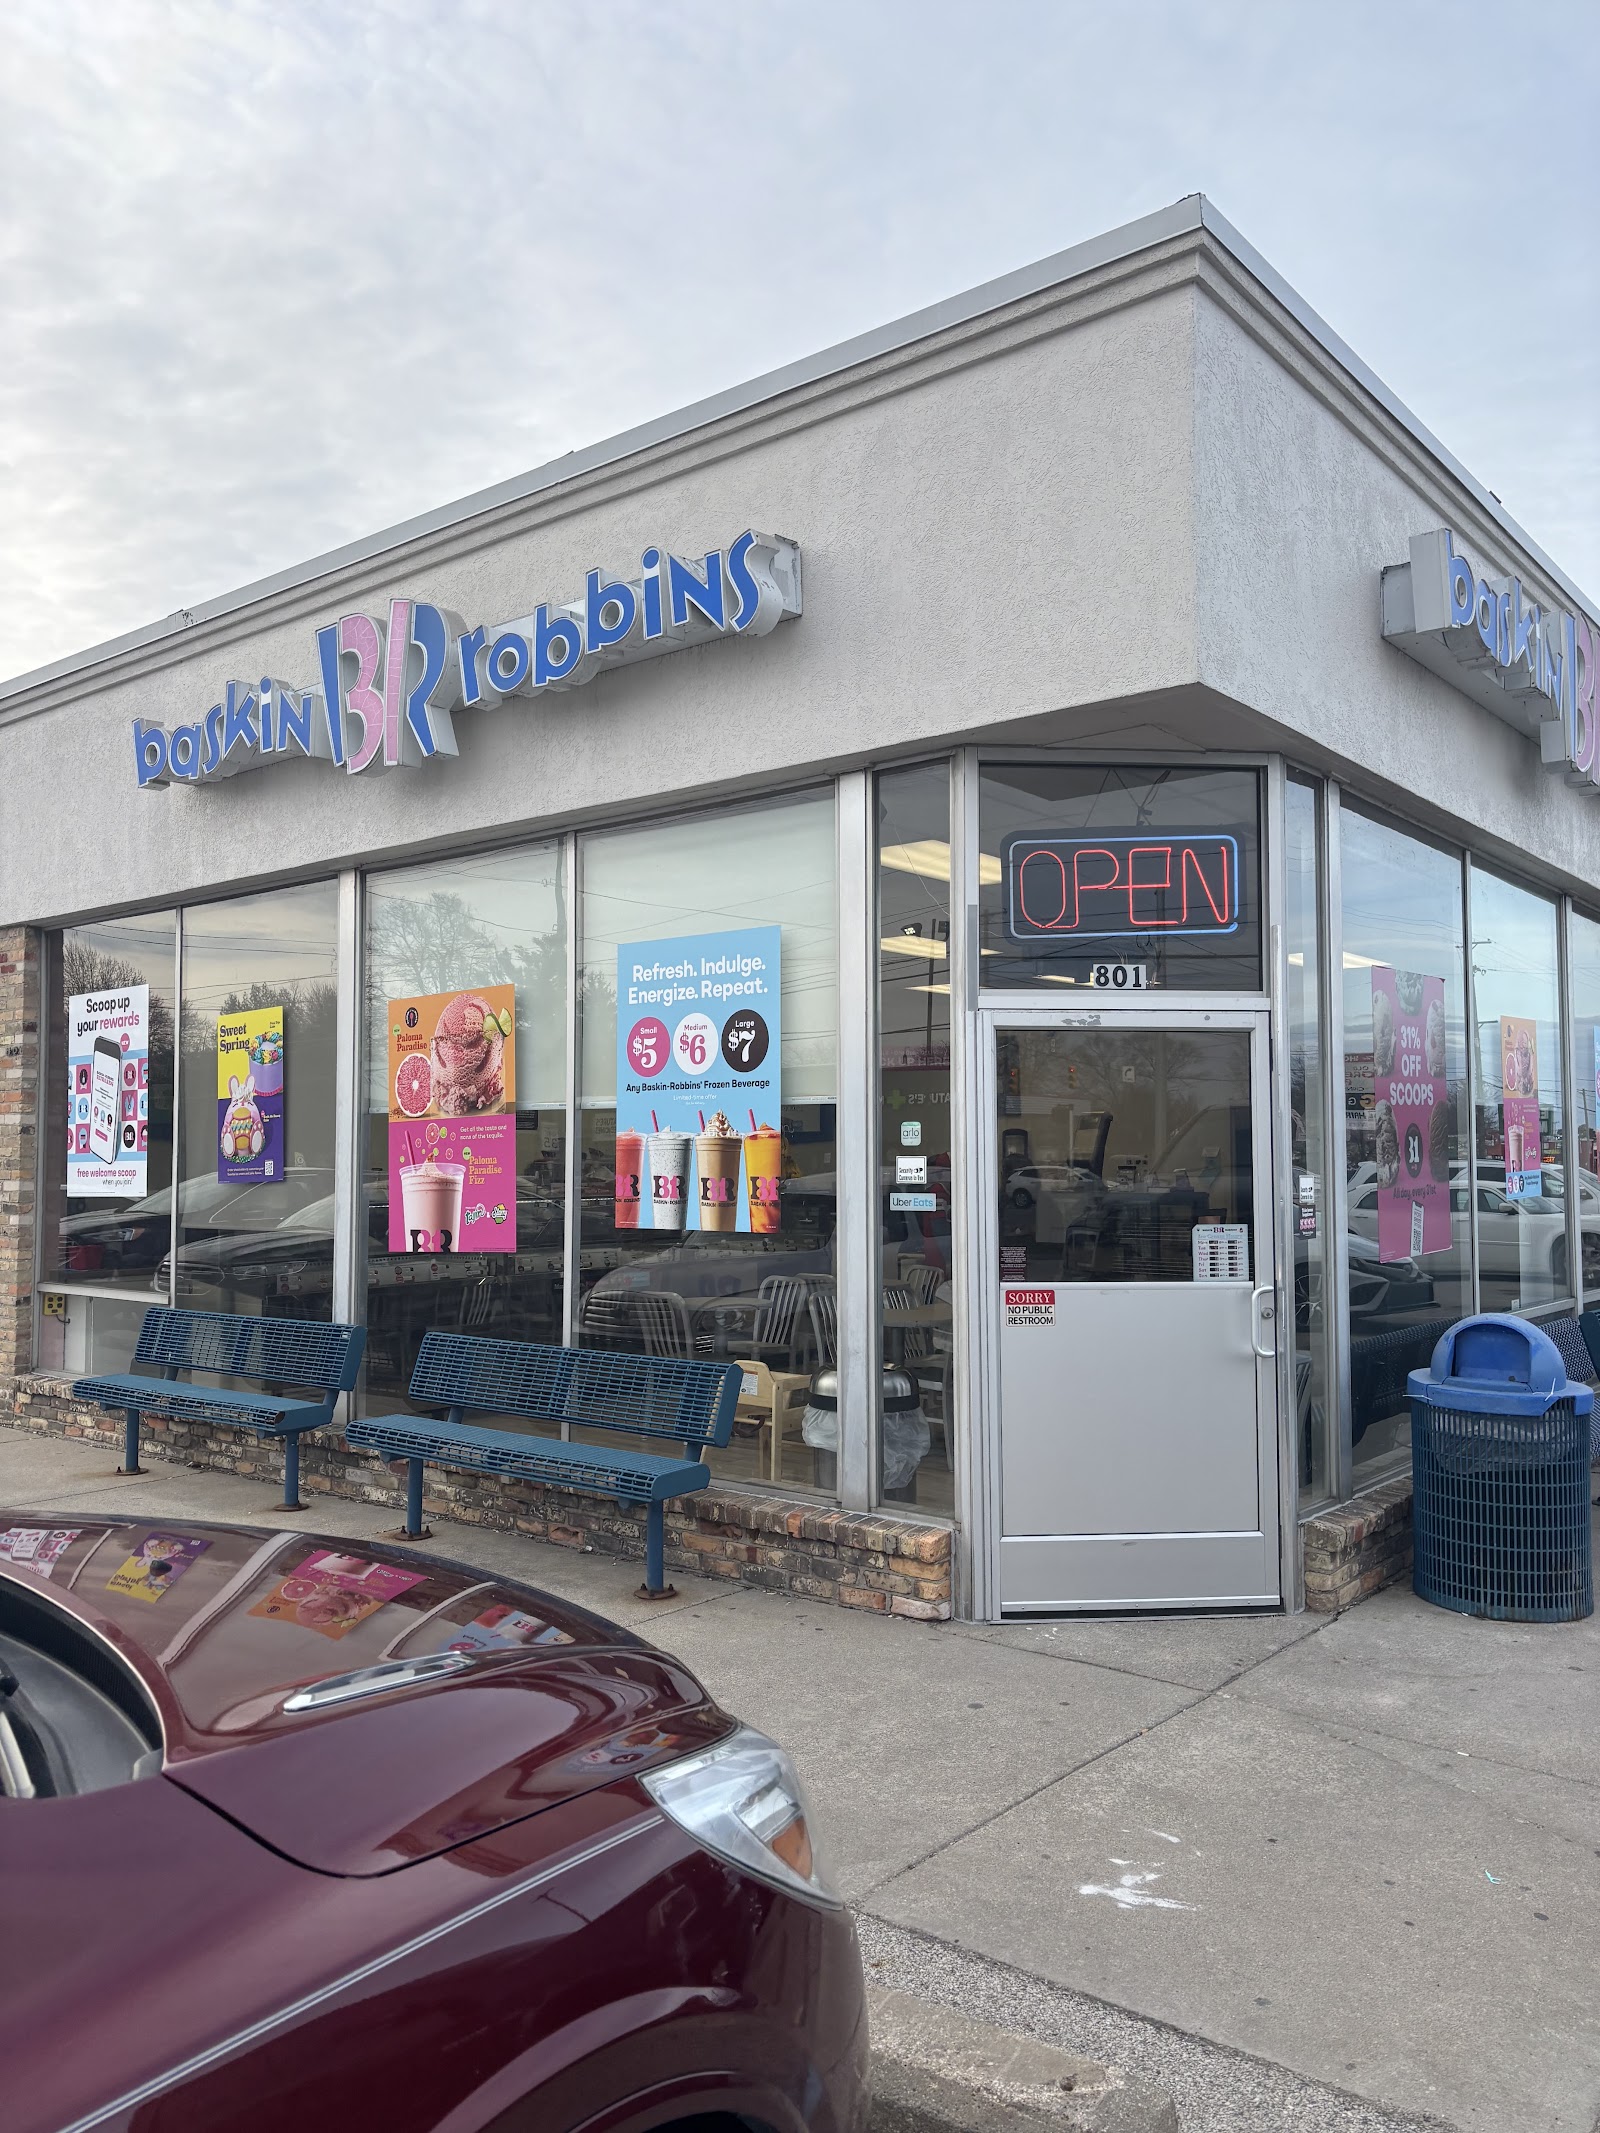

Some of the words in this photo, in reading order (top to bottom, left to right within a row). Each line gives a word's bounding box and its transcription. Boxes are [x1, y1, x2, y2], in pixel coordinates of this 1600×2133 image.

[316, 598, 448, 774] BR
[1019, 846, 1229, 929] OPEN
[632, 959, 698, 983] Refresh.
[701, 953, 766, 977] Indulge.
[1095, 965, 1143, 988] 801
[628, 982, 699, 1007] Energize.
[701, 977, 769, 1002] Repeat.
[86, 998, 117, 1015] Scoop
[117, 996, 131, 1013] up
[77, 1020, 99, 1037] your
[99, 1010, 140, 1030] rewards
[219, 1023, 247, 1038] Sweet
[640, 1026, 657, 1035] Small
[683, 1023, 708, 1031] Medium
[735, 1020, 755, 1029] Large
[396, 1033, 423, 1043] Paloma
[1400, 1024, 1421, 1050] 31%
[396, 1041, 428, 1052] Paradise
[632, 1035, 658, 1069] $5
[679, 1032, 707, 1065] $6
[728, 1028, 756, 1063] $7
[1401, 1054, 1422, 1077] OFF
[625, 1083, 641, 1094] Any
[703, 1080, 730, 1089] Frozen
[731, 1079, 771, 1091] Beverage
[1389, 1081, 1434, 1107] SCOOPS
[902, 1127, 920, 1137] arlo
[468, 1156, 497, 1165] Paloma
[77, 1168, 89, 1178] free
[90, 1167, 117, 1178] welcome
[117, 1168, 137, 1180] scoop
[468, 1165, 502, 1175] Paradise
[468, 1175, 486, 1185] Fizz
[653, 1175, 687, 1199] BR
[700, 1177, 736, 1202] BR
[892, 1197, 912, 1207] Uber
[912, 1197, 934, 1207] Eats
[1008, 1292, 1052, 1304] SORRY
[1007, 1305, 1021, 1314] NO
[1022, 1305, 1053, 1314] PUBLIC
[1007, 1316, 1054, 1325] RESTROOM
